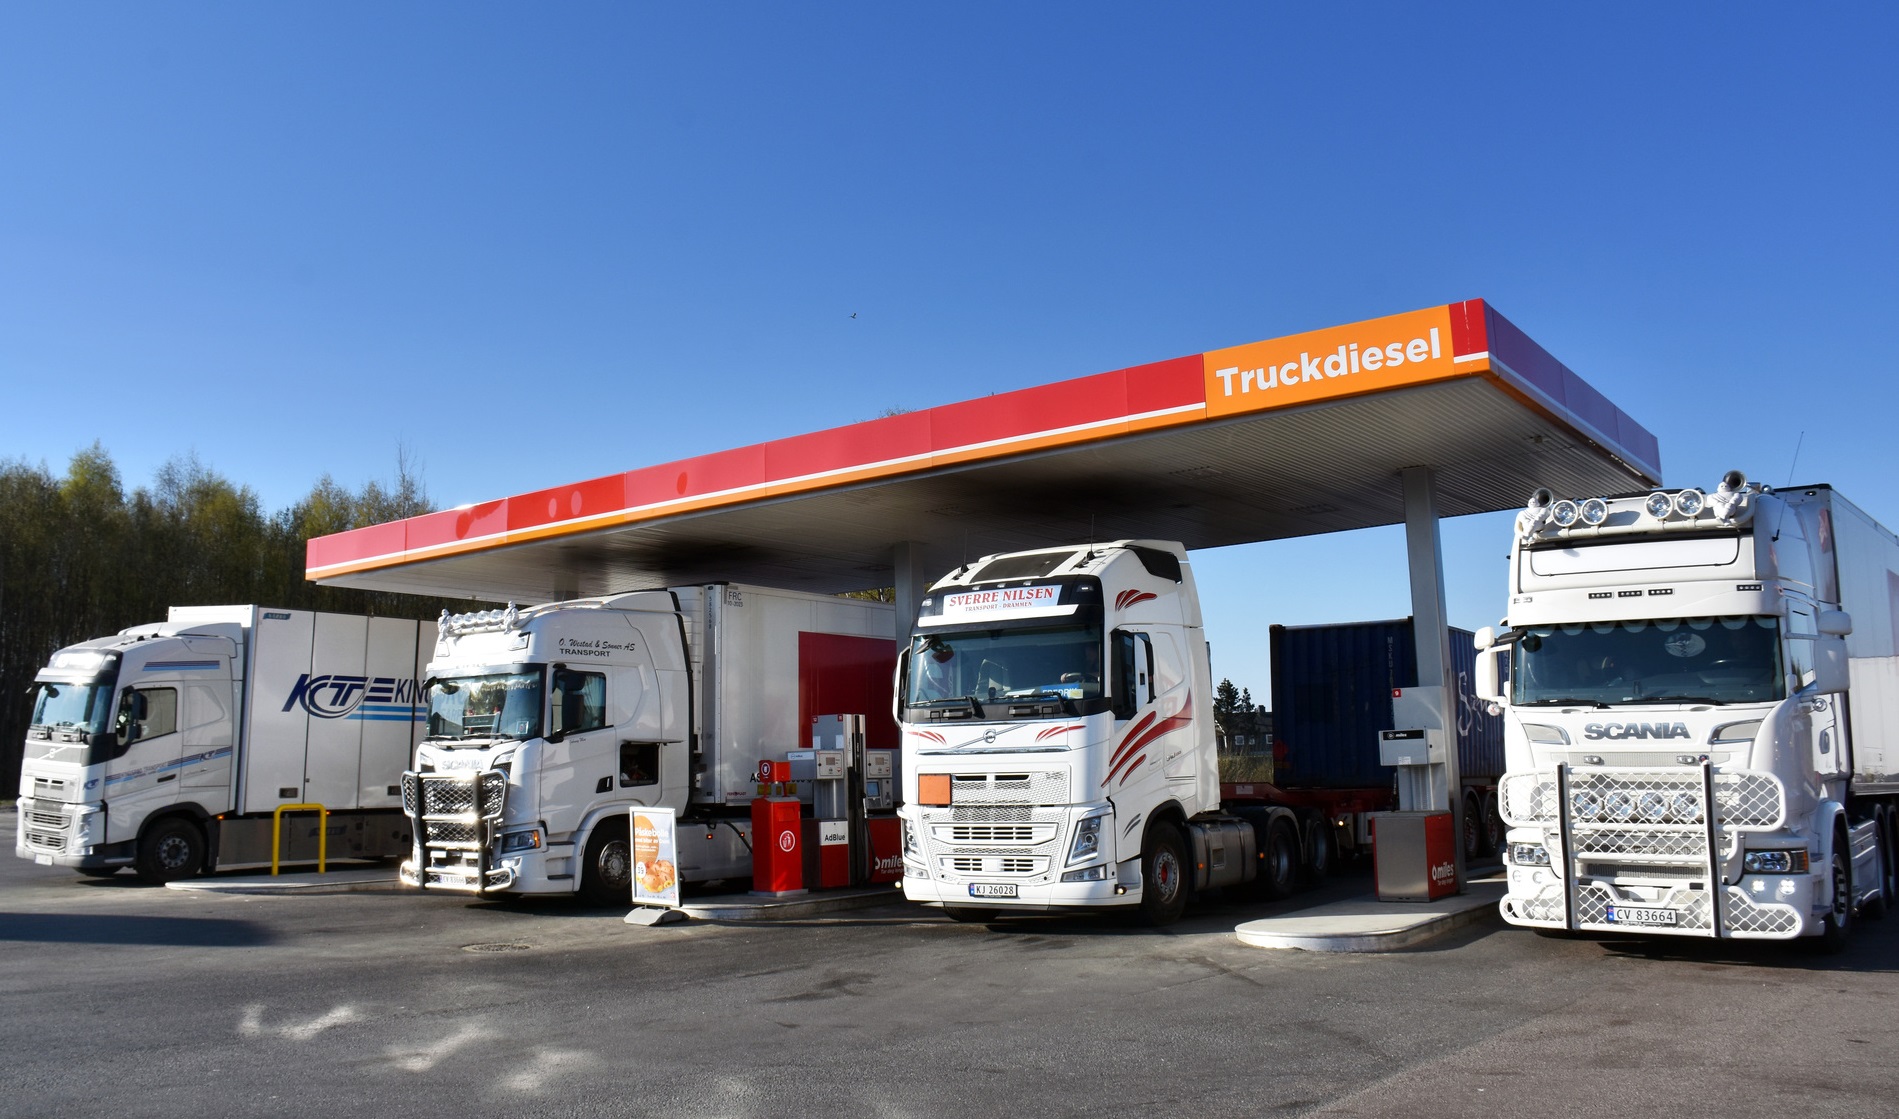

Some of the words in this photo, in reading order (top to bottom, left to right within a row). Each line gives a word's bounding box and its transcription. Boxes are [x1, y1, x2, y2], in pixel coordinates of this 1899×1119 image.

[1216, 327, 1441, 397] Truckdiesel
[728, 591, 742, 601] FRC
[949, 591, 999, 607] SVERRE
[1002, 587, 1054, 602] NILSEN
[965, 603, 998, 612] TRANSPORT
[1003, 601, 1032, 609] DRAMMEN
[559, 638, 567, 646] O.
[595, 640, 600, 648] &
[624, 643, 635, 651] AS
[560, 648, 611, 657] TRANSPORT
[1584, 721, 1692, 740] SCANIA
[824, 833, 846, 842] AdBlue
[881, 855, 904, 869] mile
[1438, 862, 1454, 879] miles
[976, 885, 986, 894] KJ
[988, 885, 1014, 895] 26028
[1616, 909, 1631, 920] CV
[1636, 910, 1674, 922] 83664
